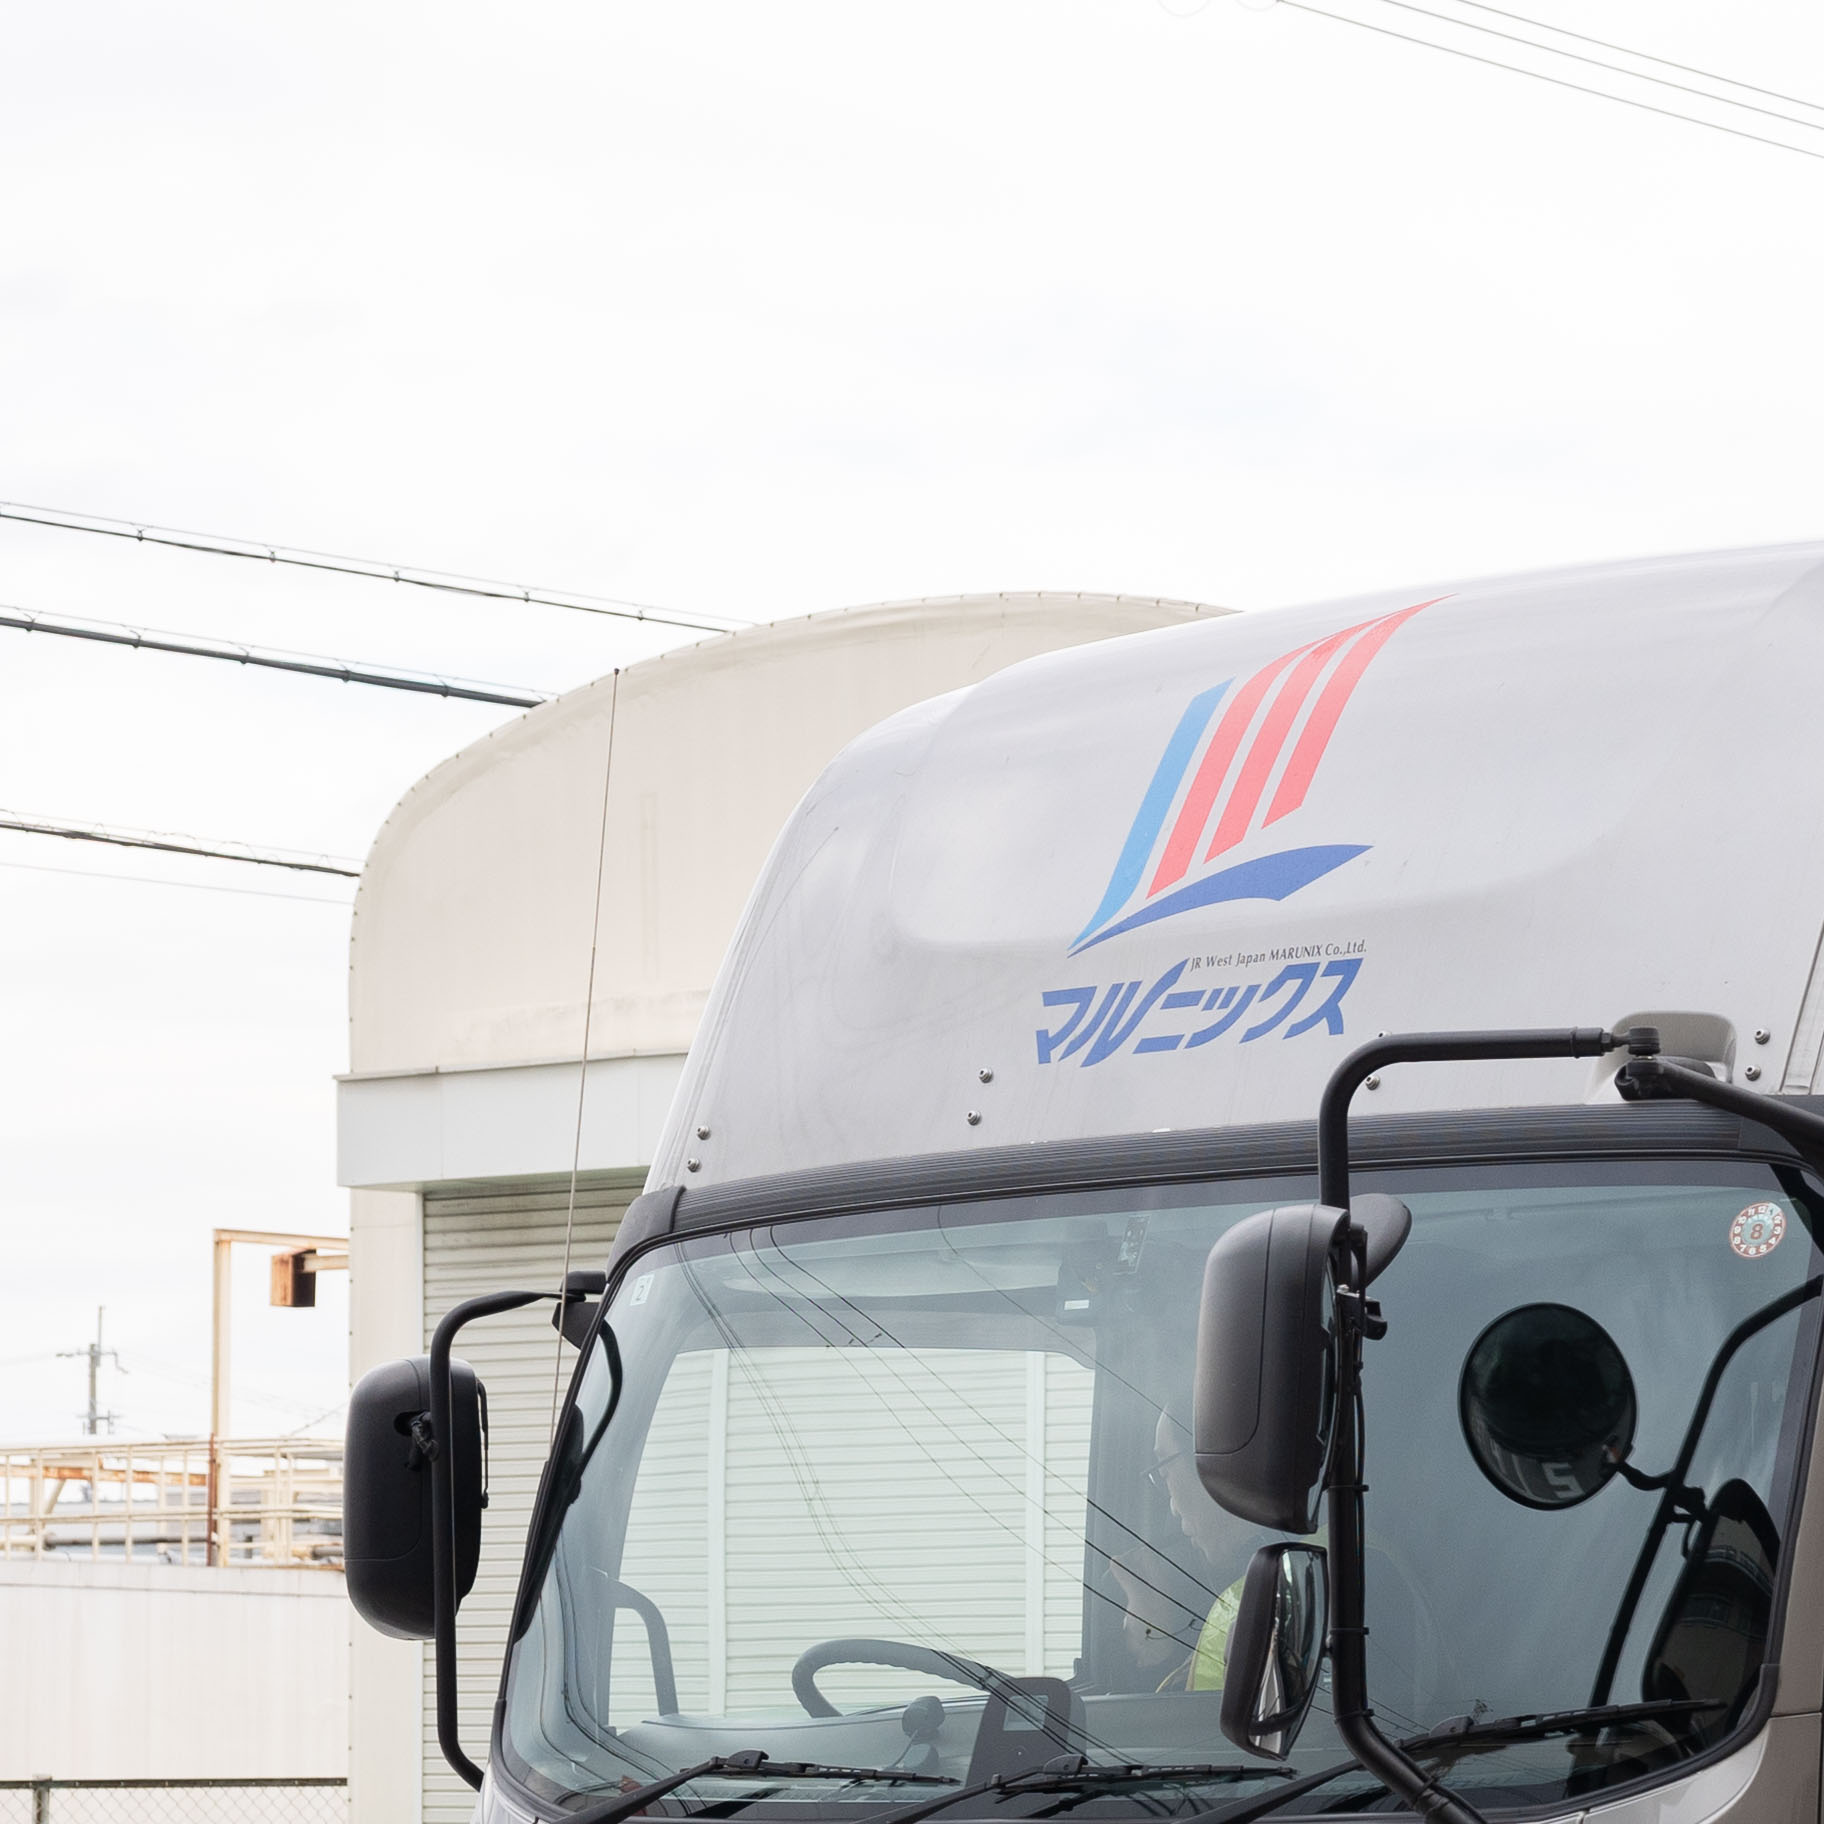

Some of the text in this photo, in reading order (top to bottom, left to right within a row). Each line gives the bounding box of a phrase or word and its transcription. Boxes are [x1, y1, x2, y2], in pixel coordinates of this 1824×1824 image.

[1190, 957, 1202, 971] JR
[1206, 954, 1232, 968] West
[1235, 952, 1266, 969] Japan
[1269, 944, 1323, 961] MARUNIX
[1036, 957, 1364, 1068] マルニックス
[1751, 1223, 1764, 1240] 8
